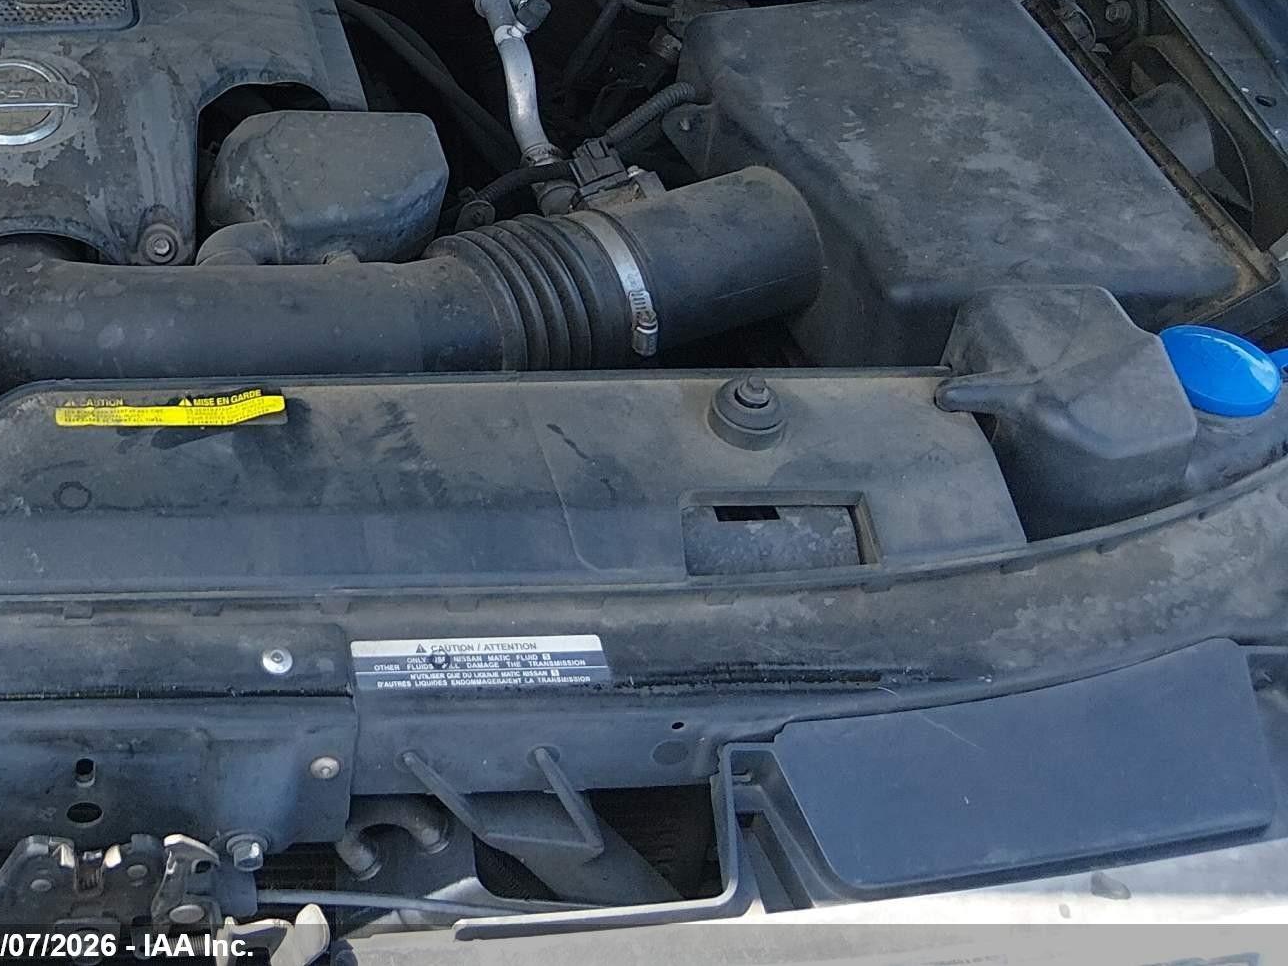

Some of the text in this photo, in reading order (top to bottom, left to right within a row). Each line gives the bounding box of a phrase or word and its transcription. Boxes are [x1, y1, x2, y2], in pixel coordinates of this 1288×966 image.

[193, 398, 214, 406] MISE
[216, 397, 229, 405] EN
[230, 389, 262, 404] GARDE
[430, 643, 475, 652] CAUTION
[483, 641, 537, 652] ATTENTION
[453, 655, 483, 663] NISSAN
[487, 654, 511, 662] MATIC
[374, 663, 400, 671] OTHER
[406, 663, 434, 671] FLUIDS
[466, 662, 500, 670] DAMAGE
[528, 659, 586, 668] TRANSMISSION
[377, 680, 412, 688] D'AUTRES
[414, 679, 448, 687] LIQUIDES
[538, 675, 591, 684] TRANSMISSION
